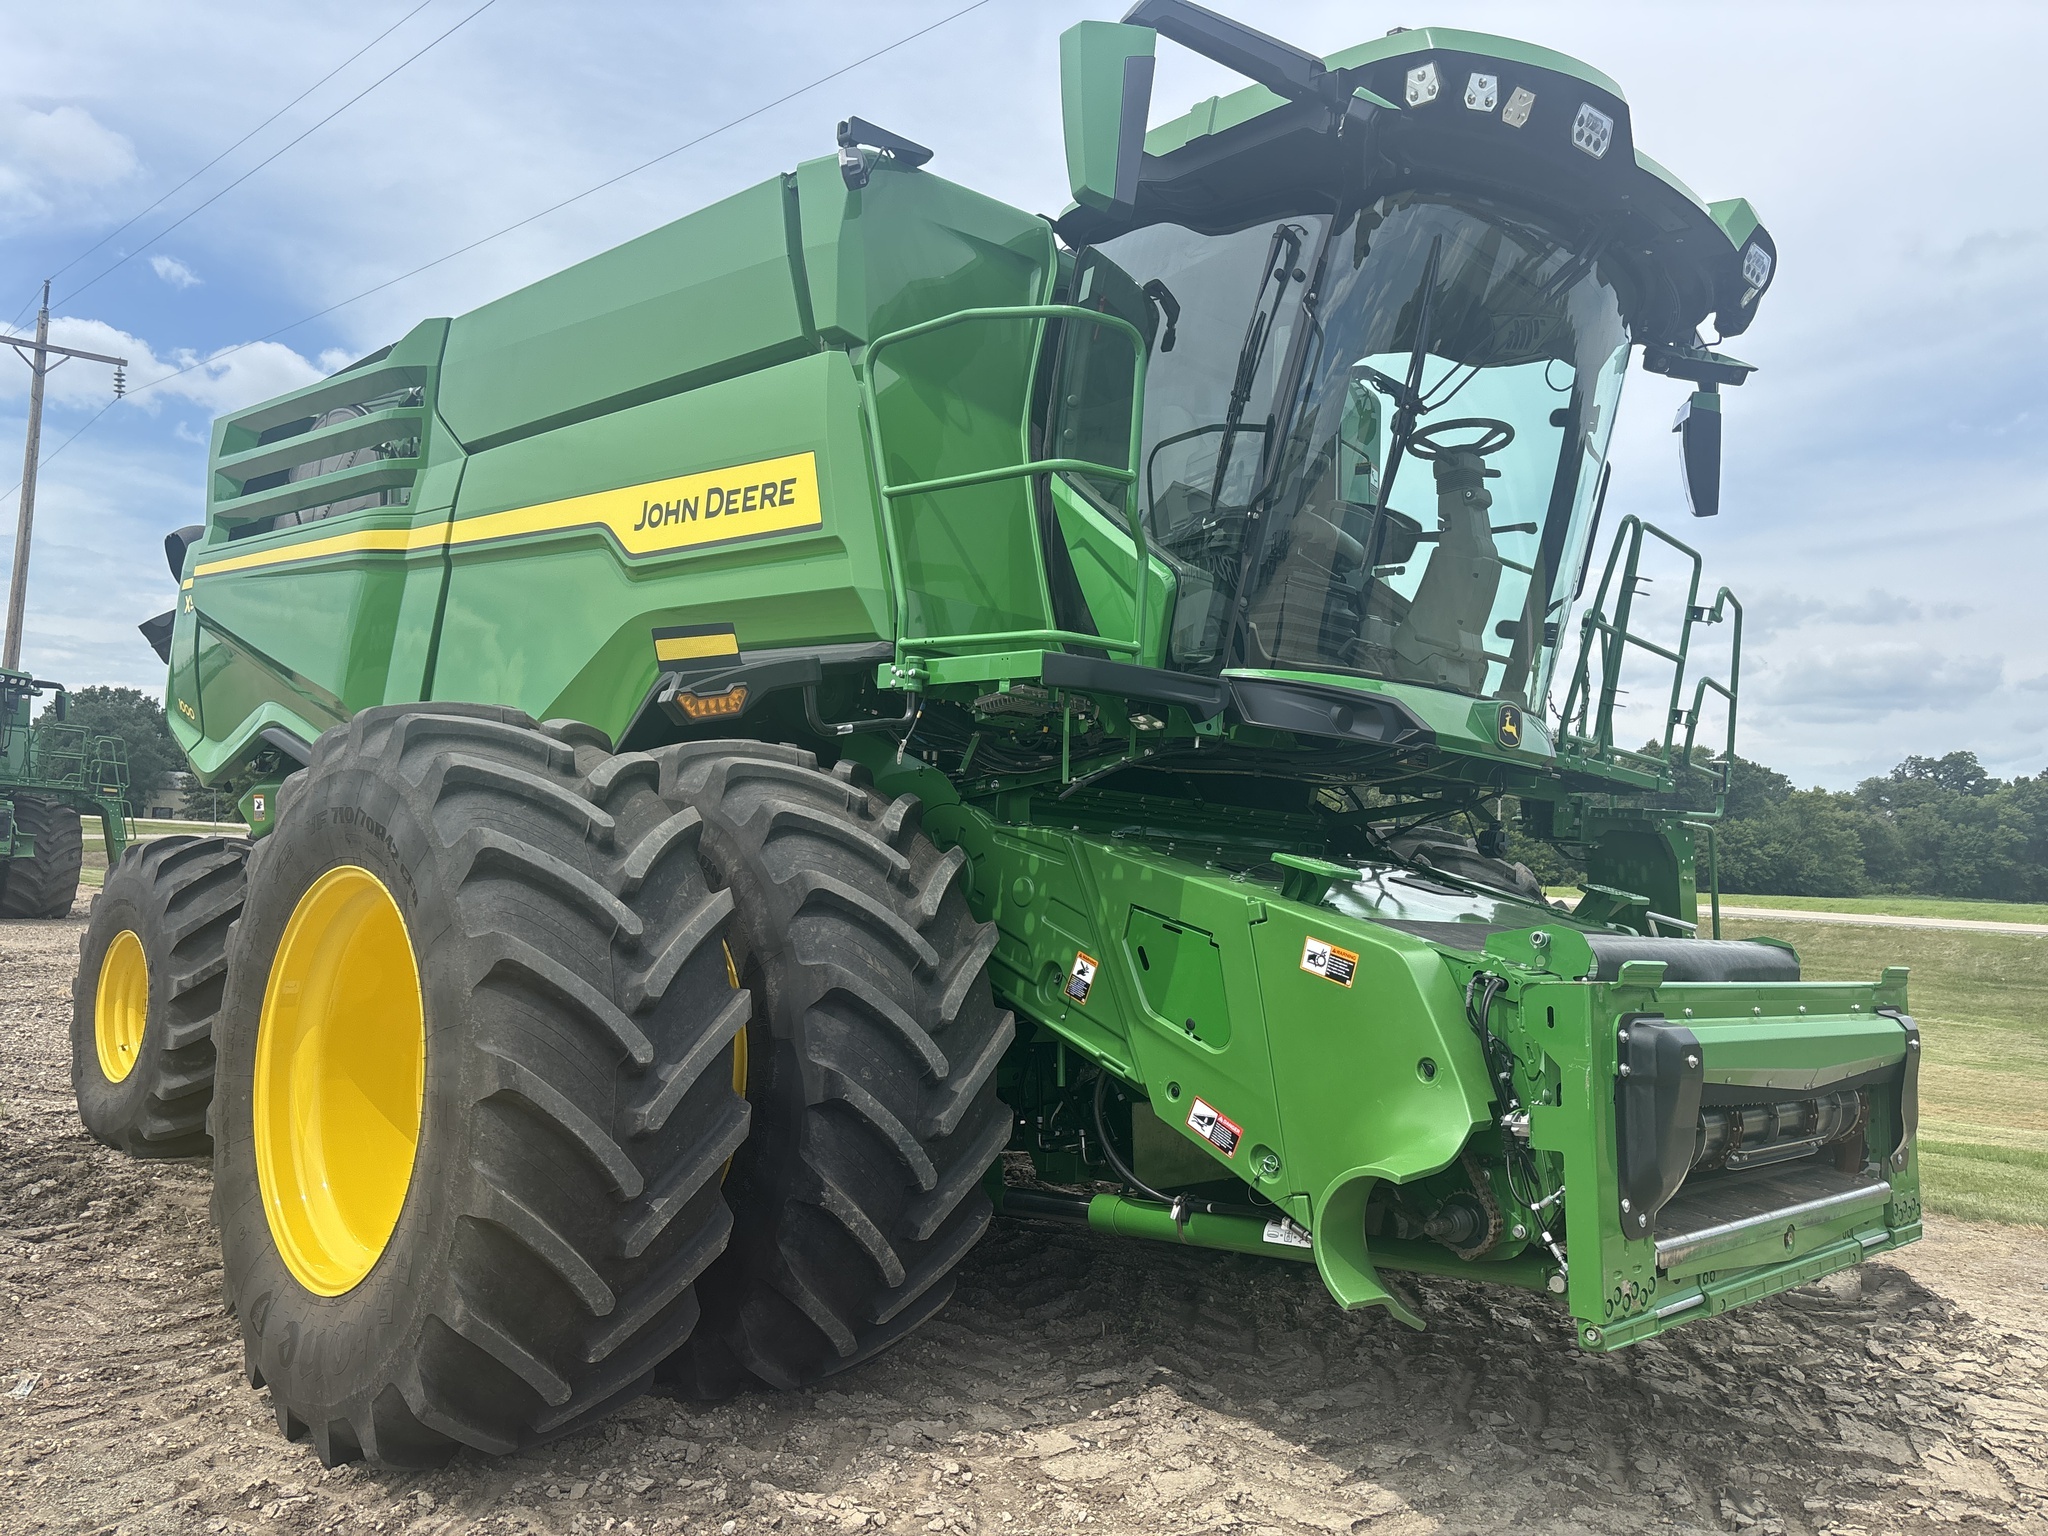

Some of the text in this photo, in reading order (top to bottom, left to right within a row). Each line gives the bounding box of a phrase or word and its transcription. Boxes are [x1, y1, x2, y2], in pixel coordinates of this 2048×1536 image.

[634, 478, 797, 531] JOHN DEERE
[178, 698, 195, 720] 1000
